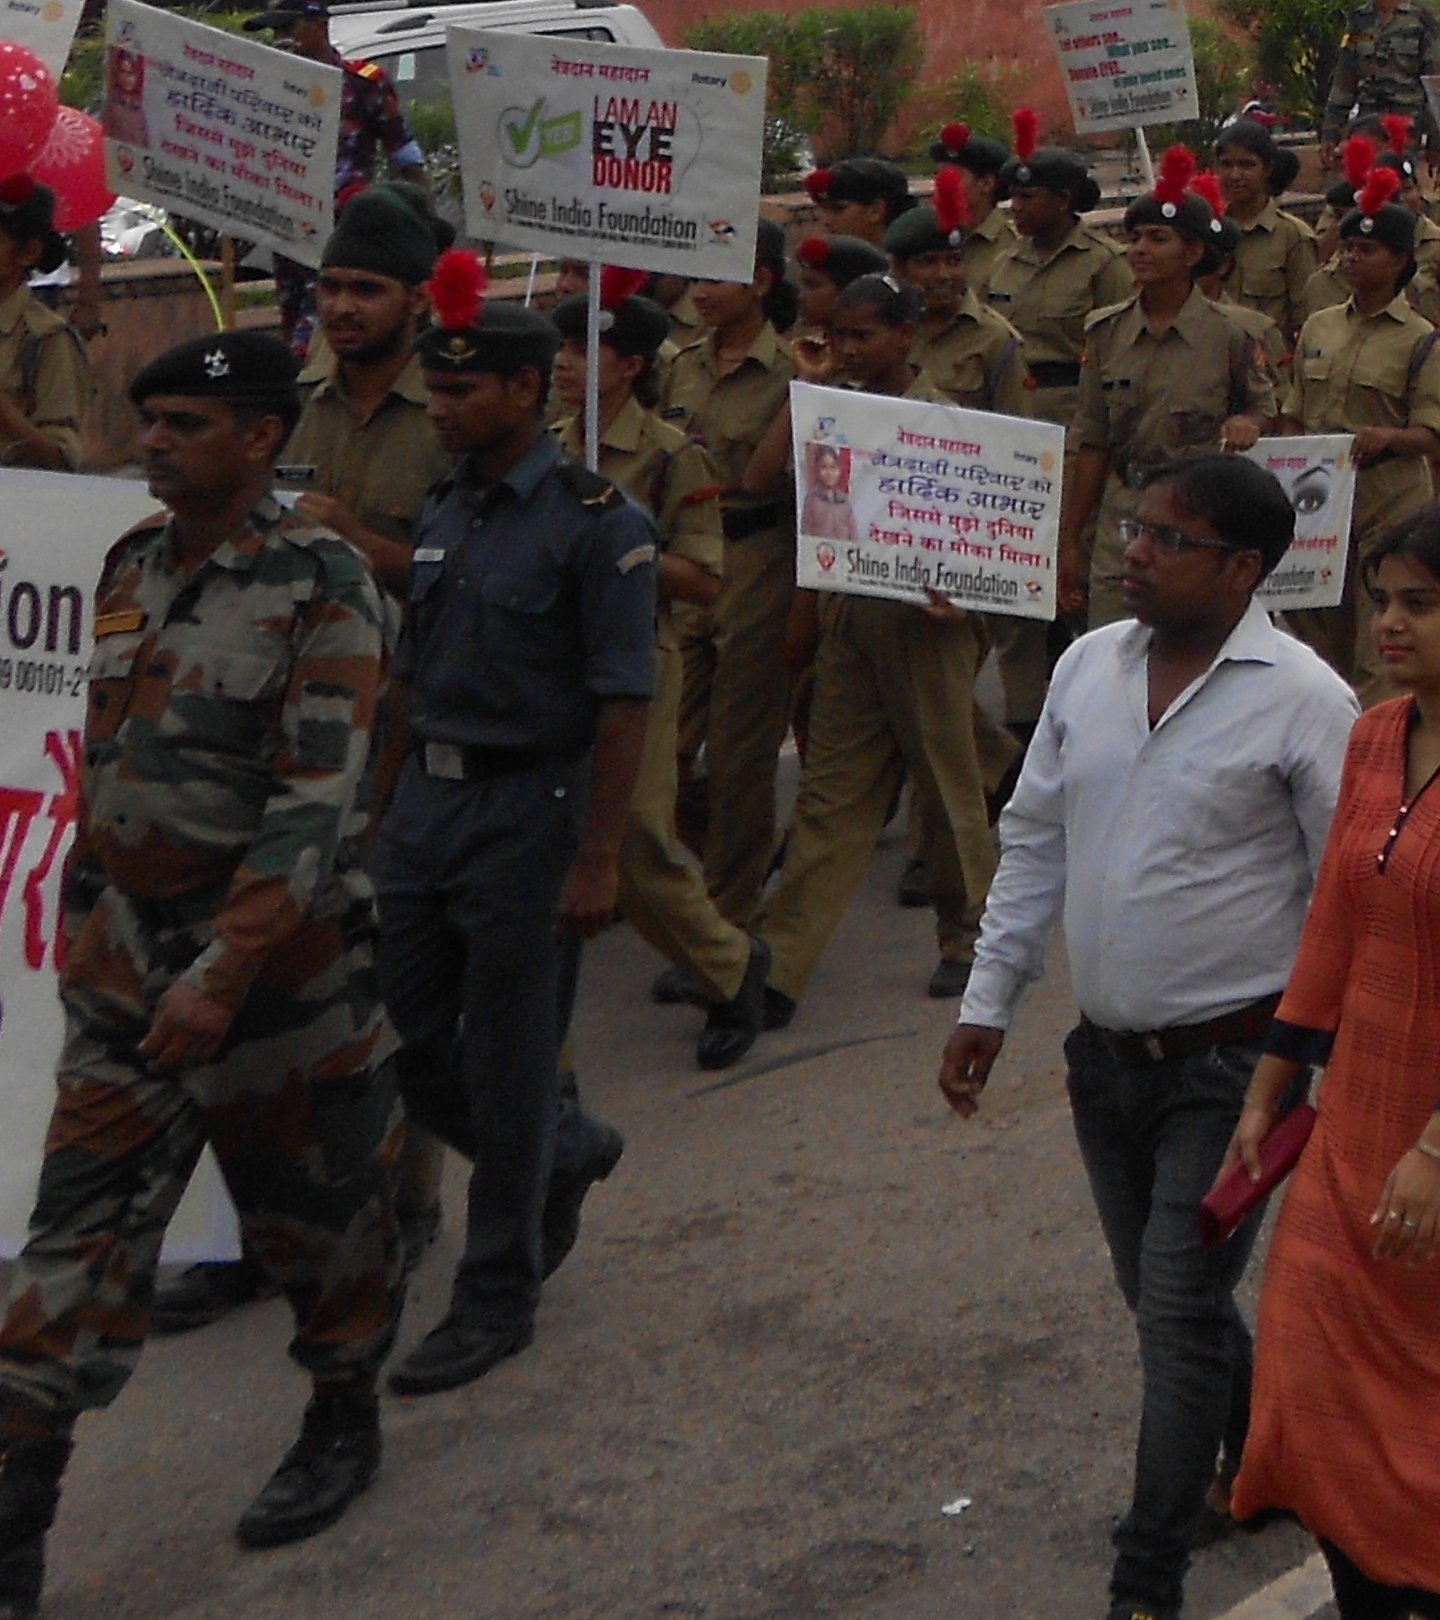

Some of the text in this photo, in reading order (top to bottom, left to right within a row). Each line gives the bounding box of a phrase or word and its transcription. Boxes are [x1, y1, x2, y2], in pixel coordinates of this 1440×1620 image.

[691, 72, 727, 88] Rotary
[593, 94, 678, 129] I AM AN
[592, 120, 675, 163] EYE
[592, 155, 673, 196] DONOR
[504, 188, 547, 221] Shine
[551, 195, 592, 229] India
[598, 202, 698, 240] Foundation
[871, 449, 1052, 495] नेत्रदानी परिवार को
[878, 474, 1046, 521] हार्दिक आभार
[920, 535, 943, 553] का
[847, 548, 890, 579] Shine
[895, 554, 931, 585] India
[935, 562, 1019, 598] Foundation
[0, 582, 83, 656] on
